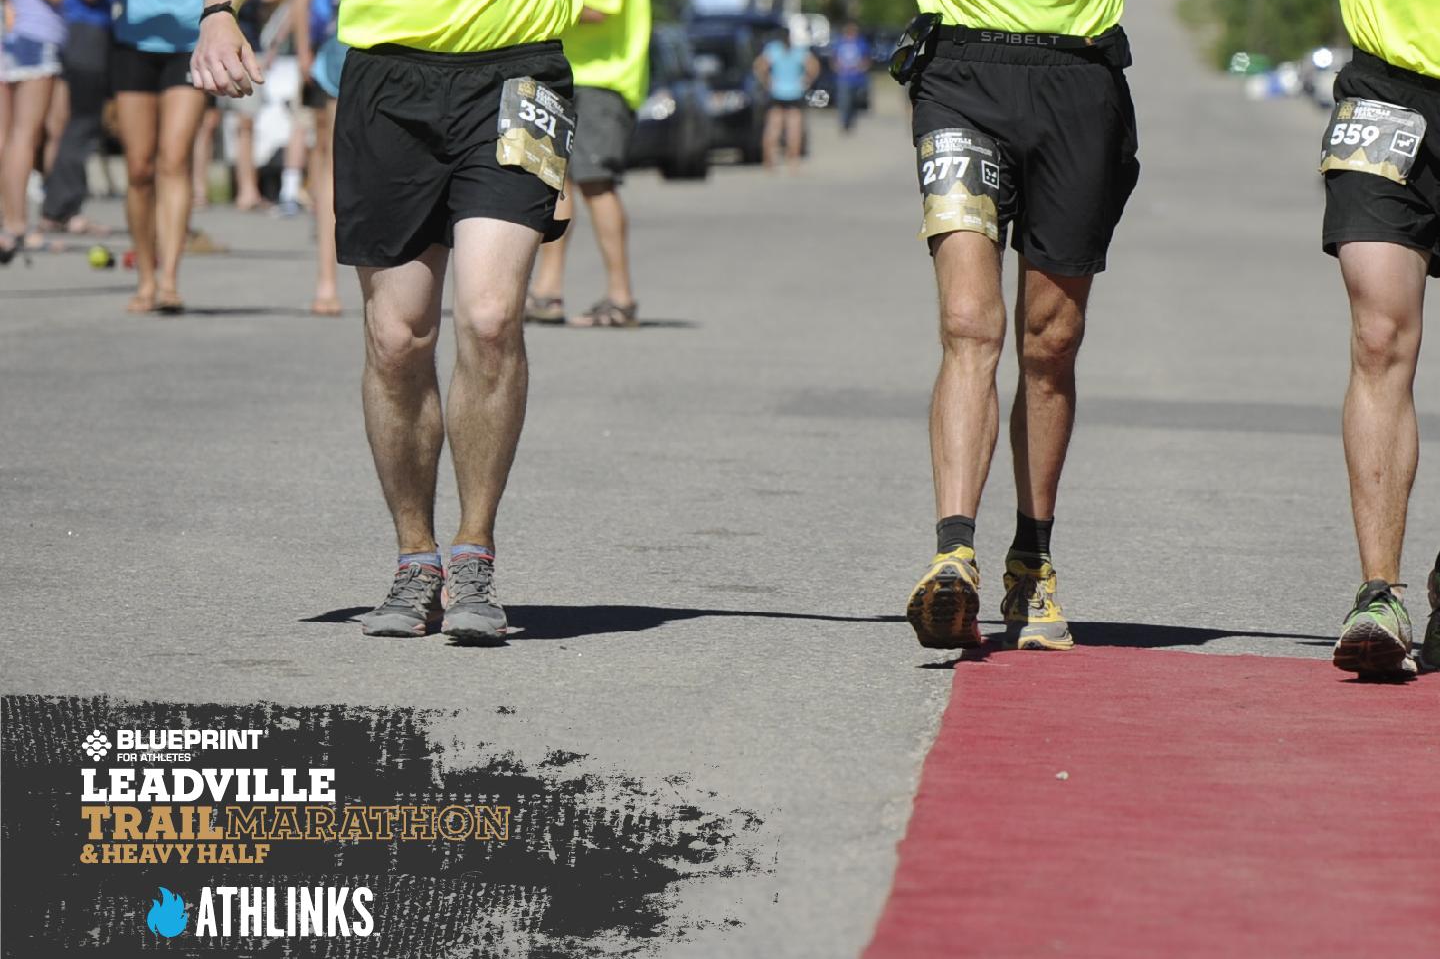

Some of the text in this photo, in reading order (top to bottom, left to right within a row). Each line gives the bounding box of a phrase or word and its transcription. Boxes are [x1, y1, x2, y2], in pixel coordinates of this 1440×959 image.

[981, 31, 1060, 45] SPIBELT
[518, 99, 557, 139] 321
[1330, 123, 1380, 147] 559
[922, 156, 971, 186] 277
